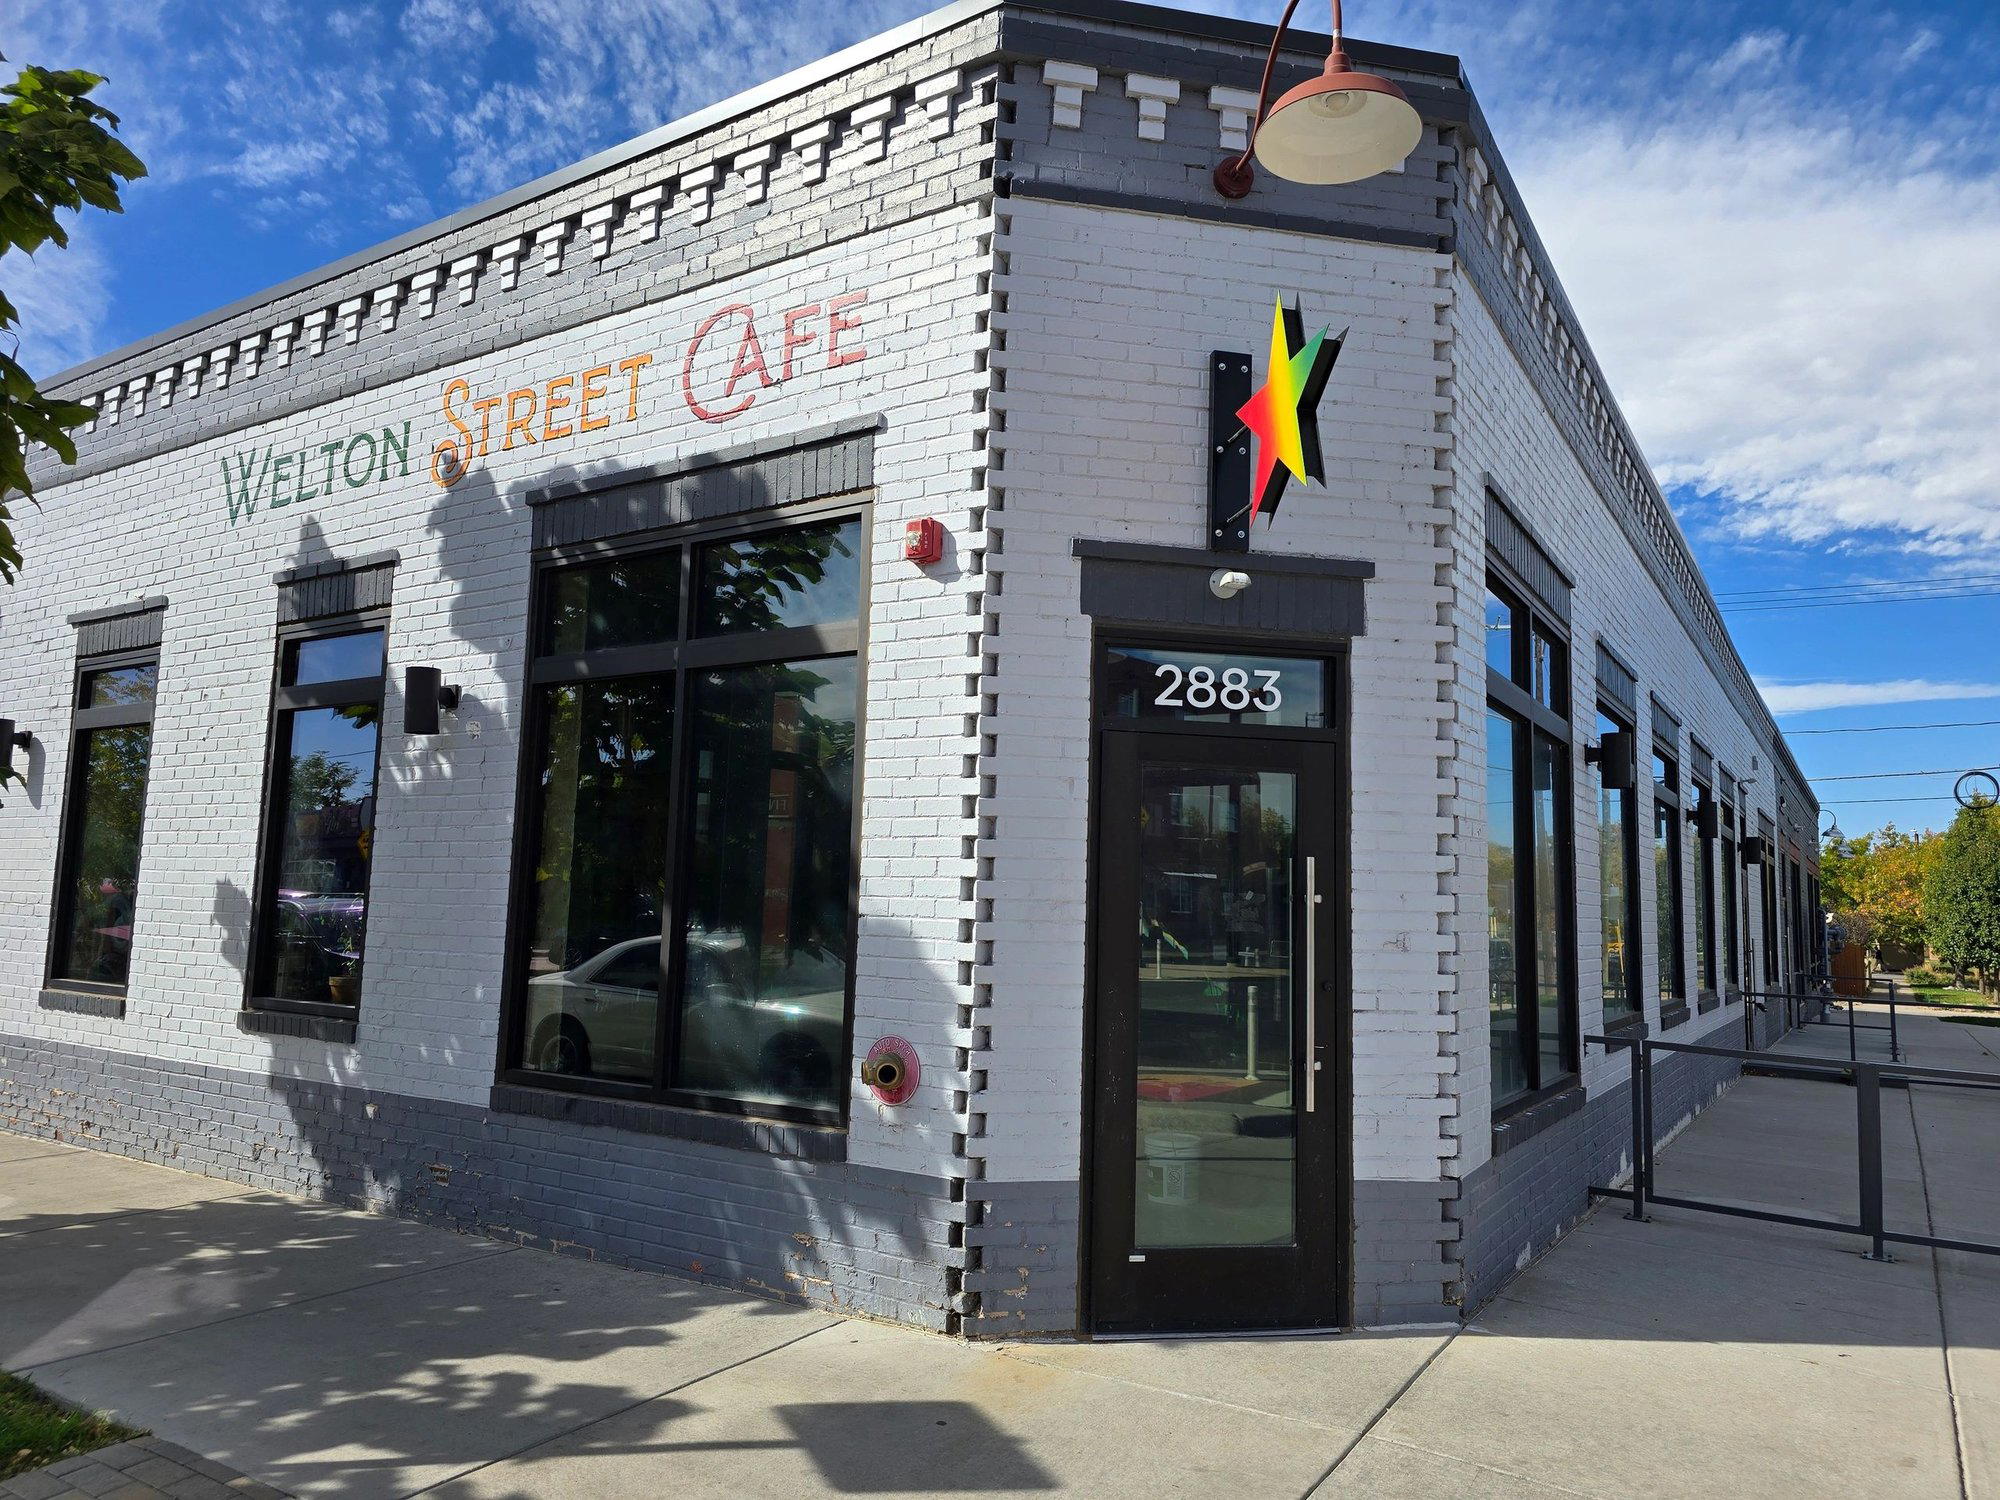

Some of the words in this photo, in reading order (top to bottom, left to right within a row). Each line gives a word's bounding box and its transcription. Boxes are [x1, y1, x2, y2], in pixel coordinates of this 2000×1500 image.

[221, 420, 411, 527] WELTON
[431, 354, 653, 487] STREET
[683, 289, 869, 423] CAFE
[1154, 664, 1282, 712] 2883
[873, 1038, 890, 1054] AUTO
